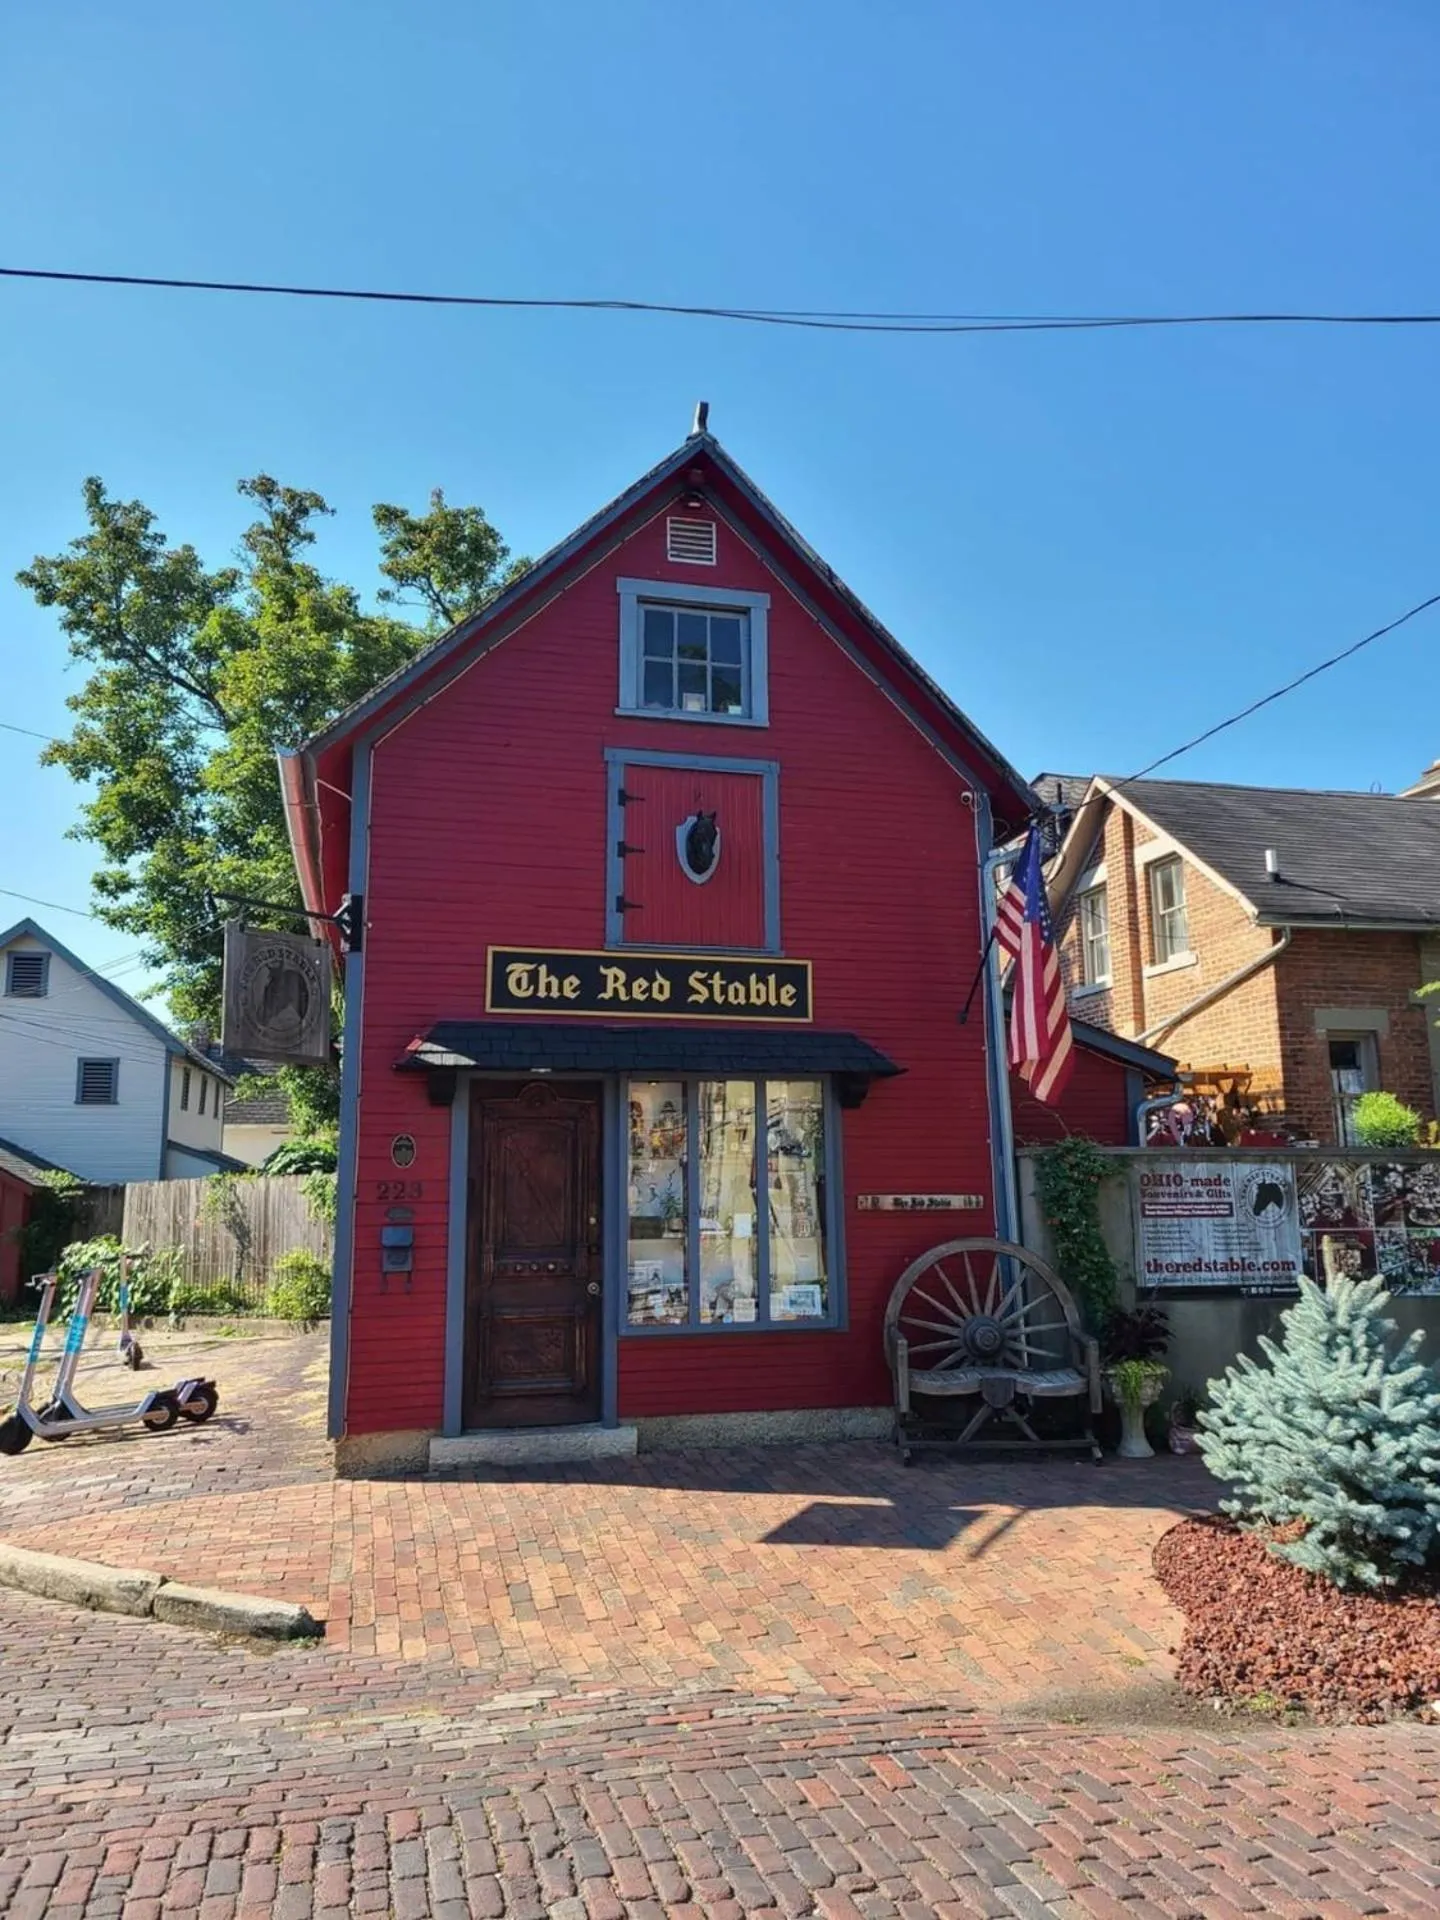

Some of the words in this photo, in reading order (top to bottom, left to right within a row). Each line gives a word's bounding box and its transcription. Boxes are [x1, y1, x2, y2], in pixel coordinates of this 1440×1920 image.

[506, 962, 581, 999] The
[597, 965, 671, 1001] Red
[687, 971, 797, 1007] Stable
[1140, 1173, 1231, 1187] OHIO-made
[376, 1181, 423, 1200] 223
[1145, 1256, 1296, 1274] theredstable.com
